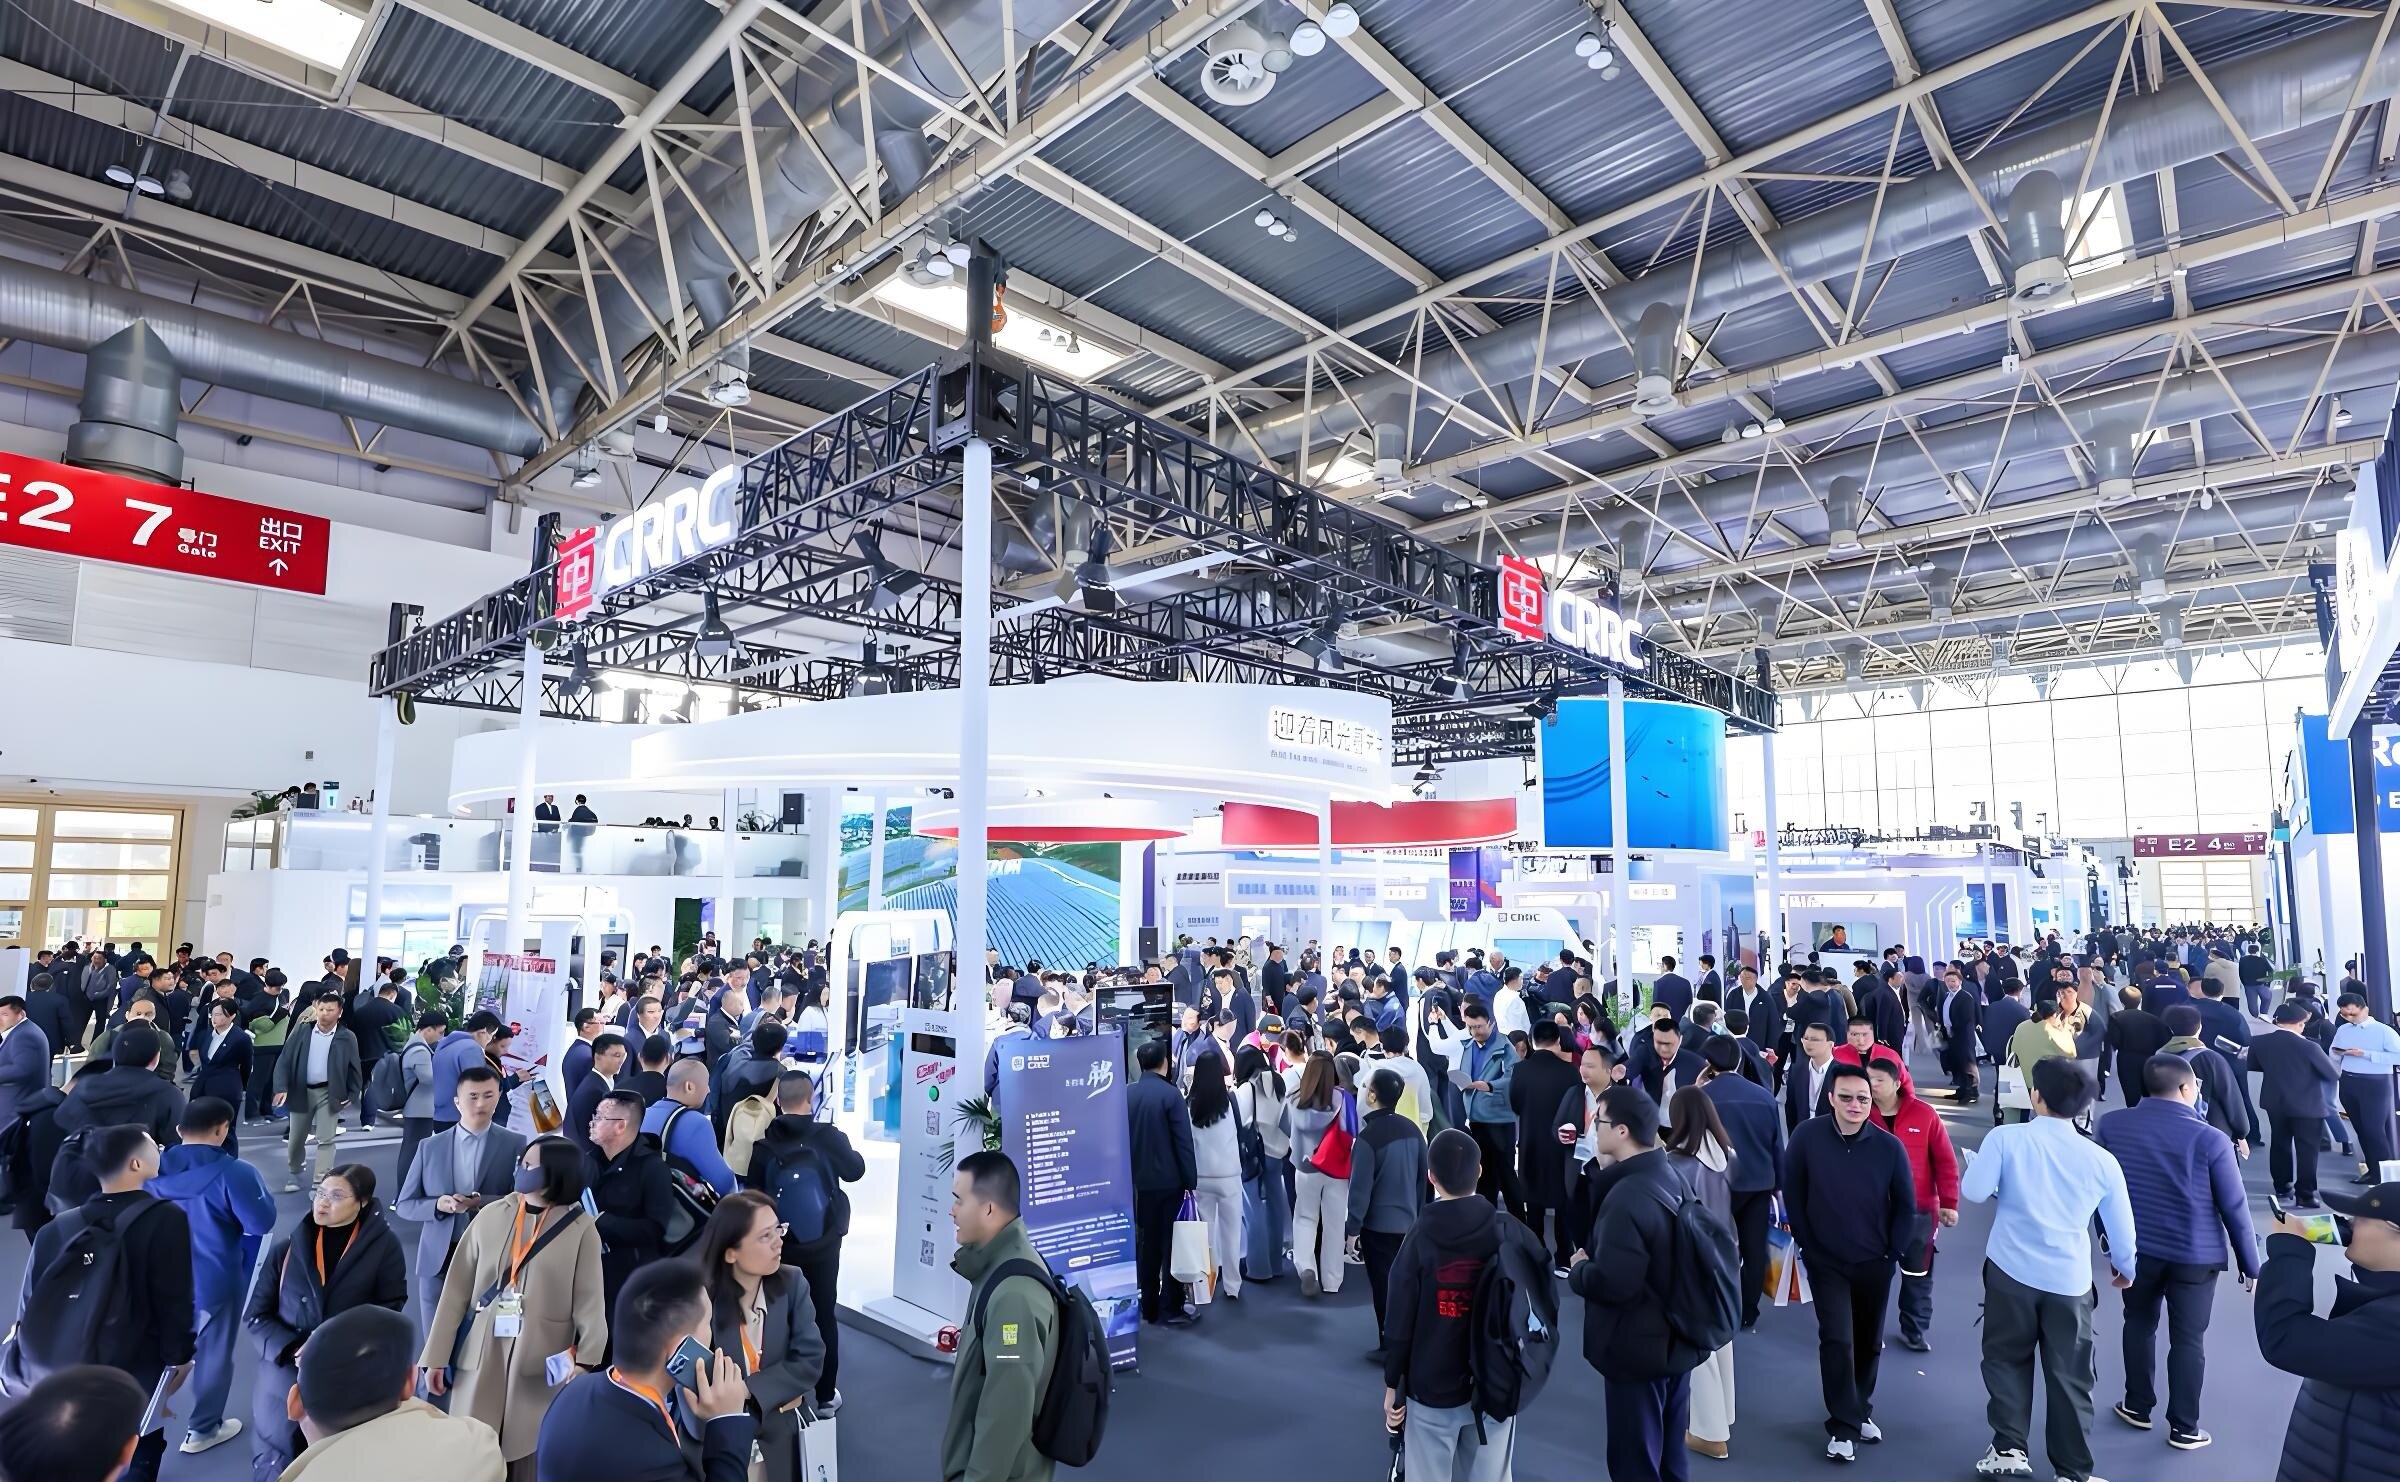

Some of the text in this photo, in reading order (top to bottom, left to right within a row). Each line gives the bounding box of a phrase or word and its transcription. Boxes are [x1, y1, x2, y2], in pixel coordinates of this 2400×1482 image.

[0, 474, 74, 533] 2
[126, 498, 173, 546] 7
[260, 517, 302, 541] 出口
[605, 464, 736, 586] CRRC
[259, 536, 301, 555] EXIT
[1553, 589, 1645, 670] CRRC
[2169, 838, 2198, 851] E2
[2208, 837, 2222, 851] 4
